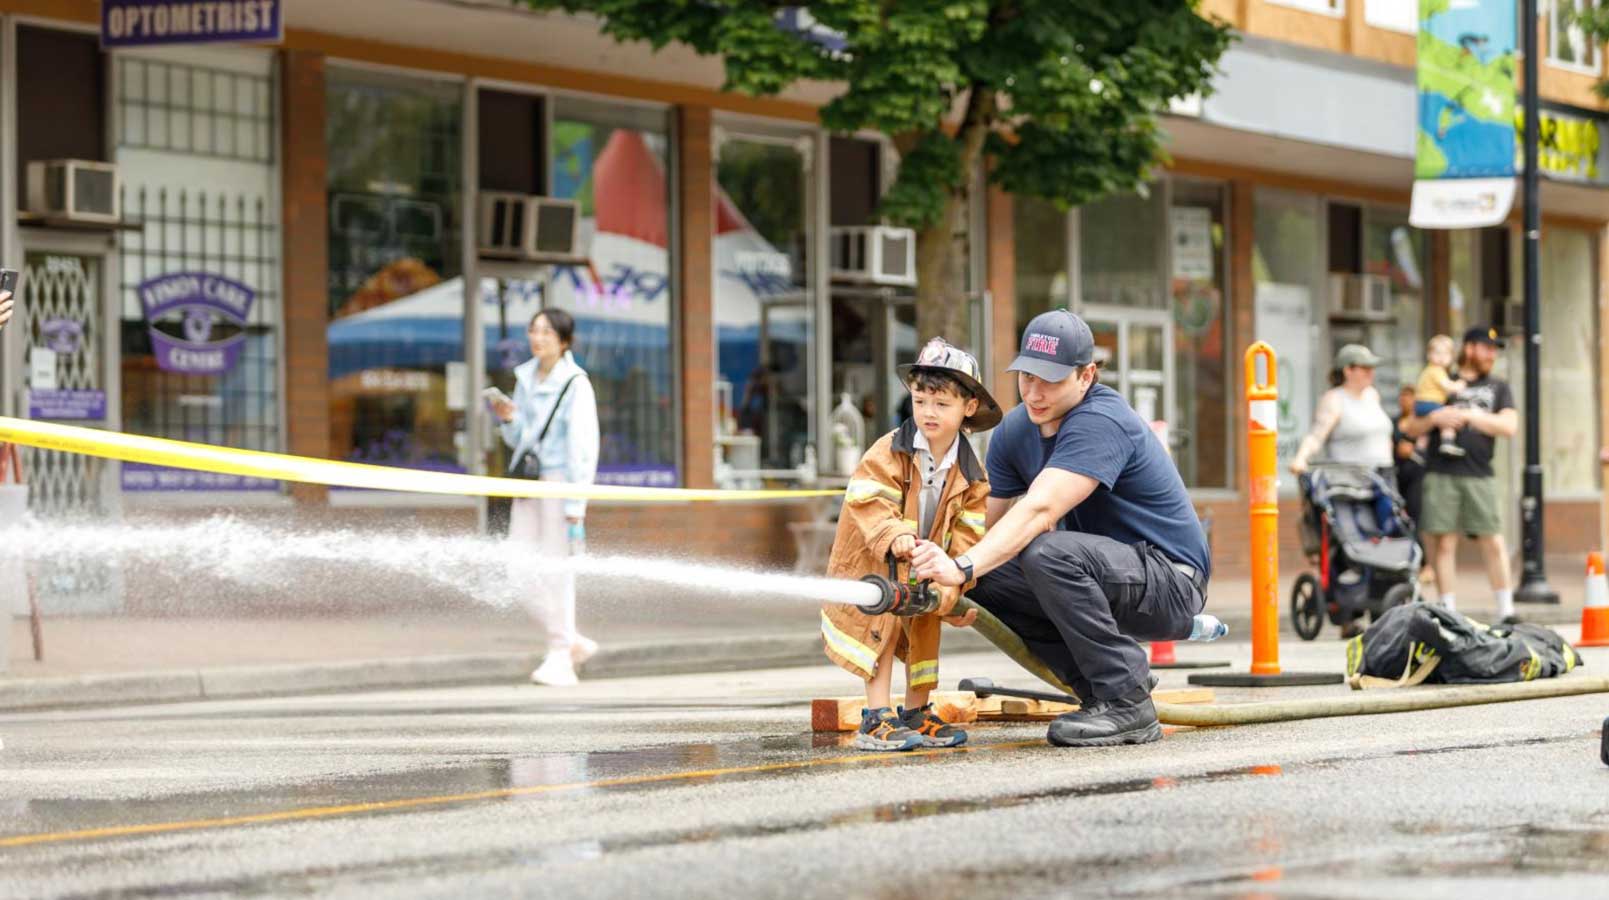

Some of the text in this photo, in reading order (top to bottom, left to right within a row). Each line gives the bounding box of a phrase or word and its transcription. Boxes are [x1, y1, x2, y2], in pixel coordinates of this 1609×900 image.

[109, 1, 273, 38] OPTOMETRIST
[203, 278, 247, 314] CARE
[1026, 336, 1058, 355] FIRE
